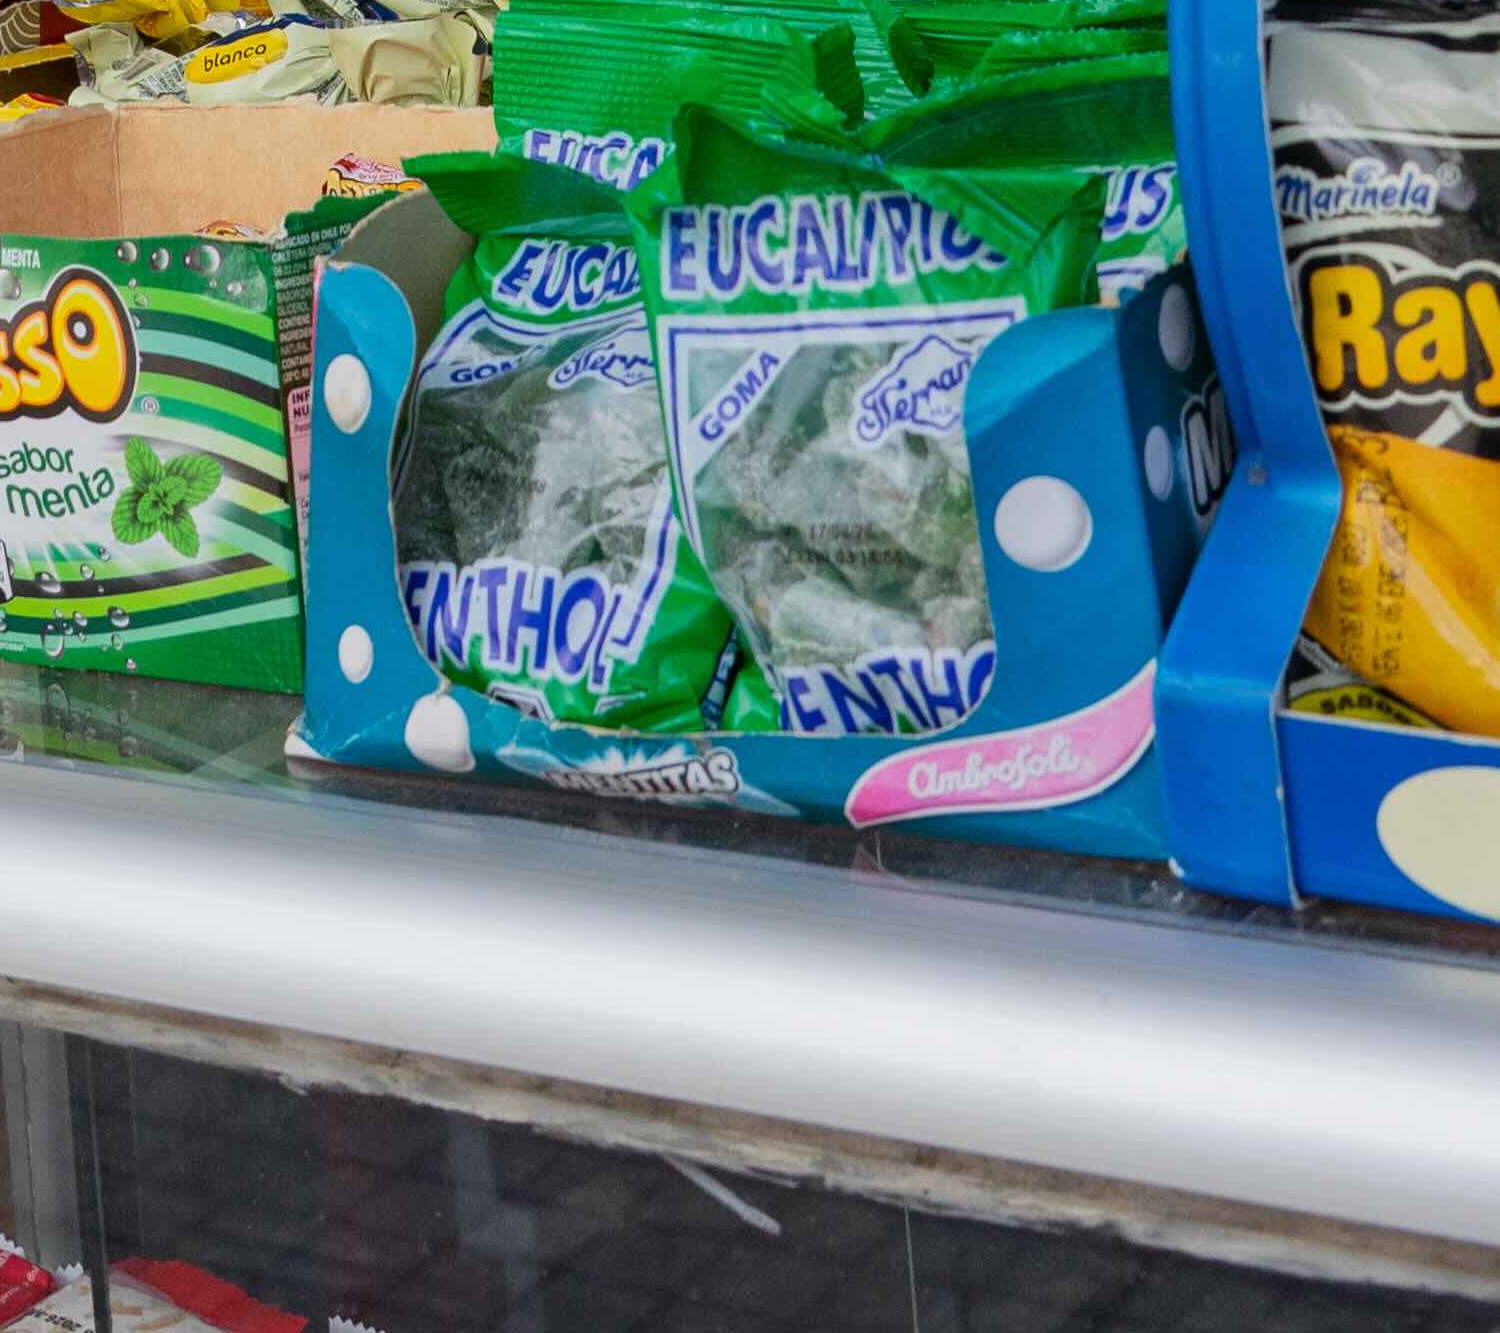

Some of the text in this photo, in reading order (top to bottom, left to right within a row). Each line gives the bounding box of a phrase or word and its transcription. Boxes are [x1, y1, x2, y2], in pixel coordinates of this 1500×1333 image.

[204, 42, 267, 73] blanco
[1278, 160, 1435, 219] Marinela
[1, 247, 41, 270] MENTA
[697, 348, 780, 444] GOMA
[5, 461, 116, 520] menta
